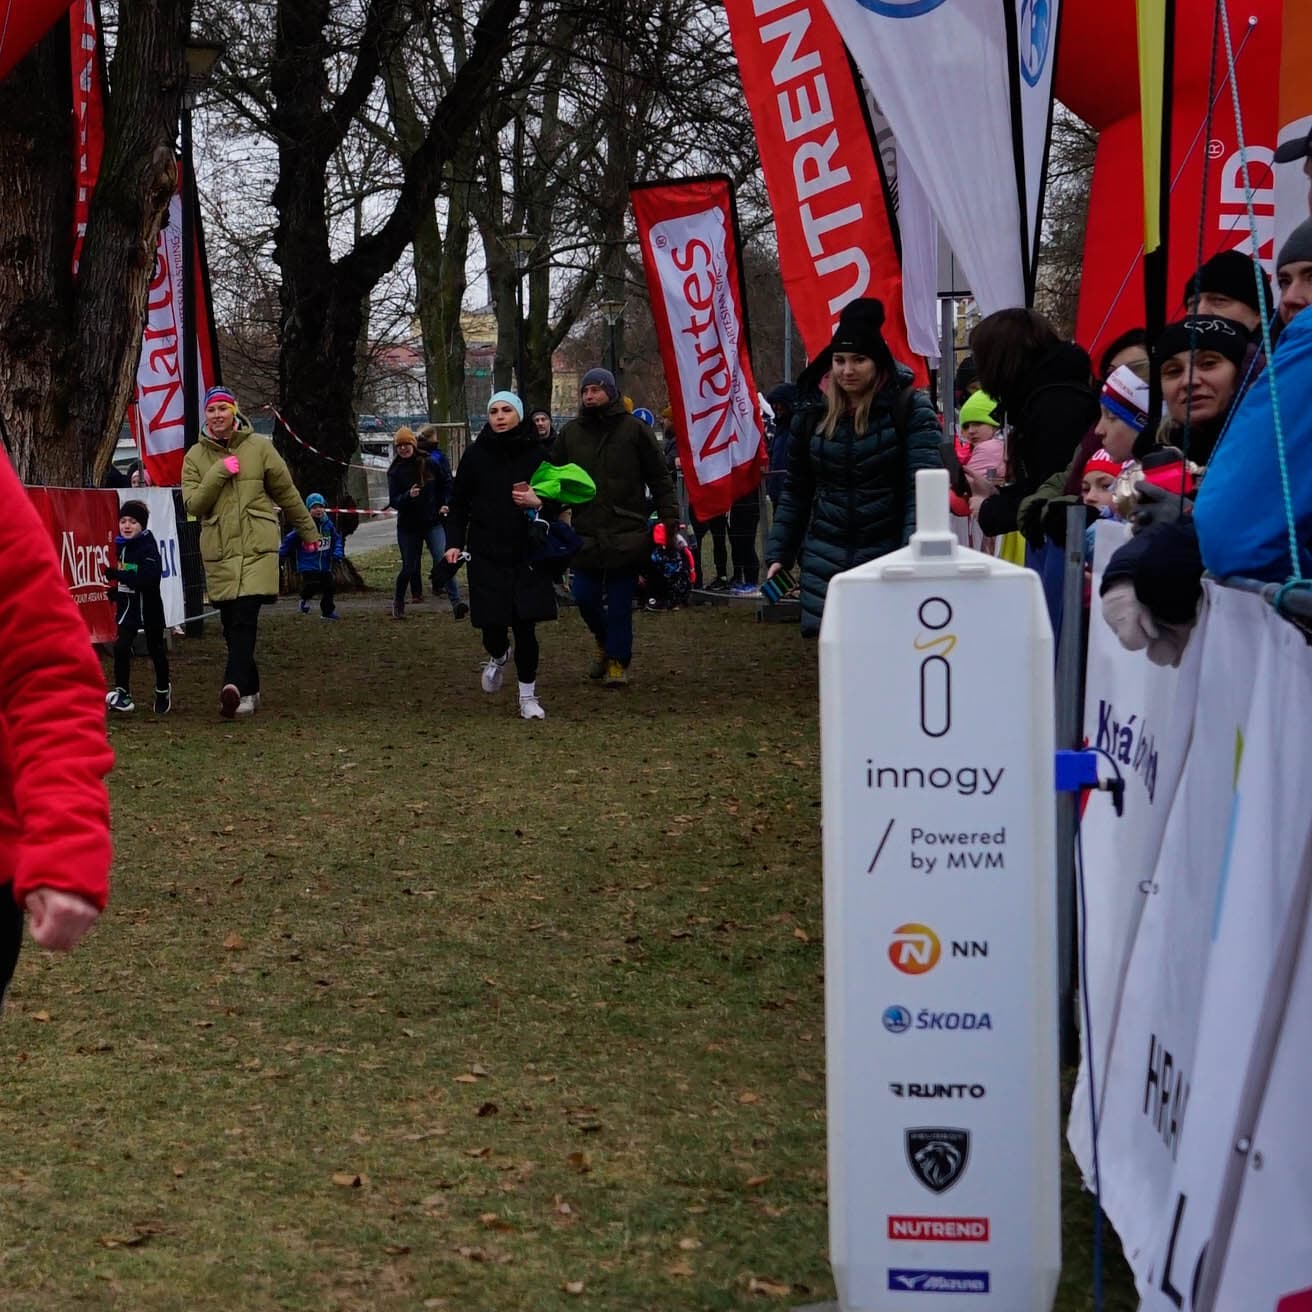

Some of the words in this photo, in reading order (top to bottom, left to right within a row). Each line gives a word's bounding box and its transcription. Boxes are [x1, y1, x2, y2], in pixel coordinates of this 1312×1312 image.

[671, 237, 740, 462] Nartes
[866, 758, 1005, 795] innogy
[910, 827, 1006, 844] Powered
[910, 852, 937, 874] by
[947, 852, 1005, 869] MVM
[952, 941, 988, 957] NN
[916, 1009, 992, 1030] ŠKODA
[892, 1220, 985, 1237] NUTREND
